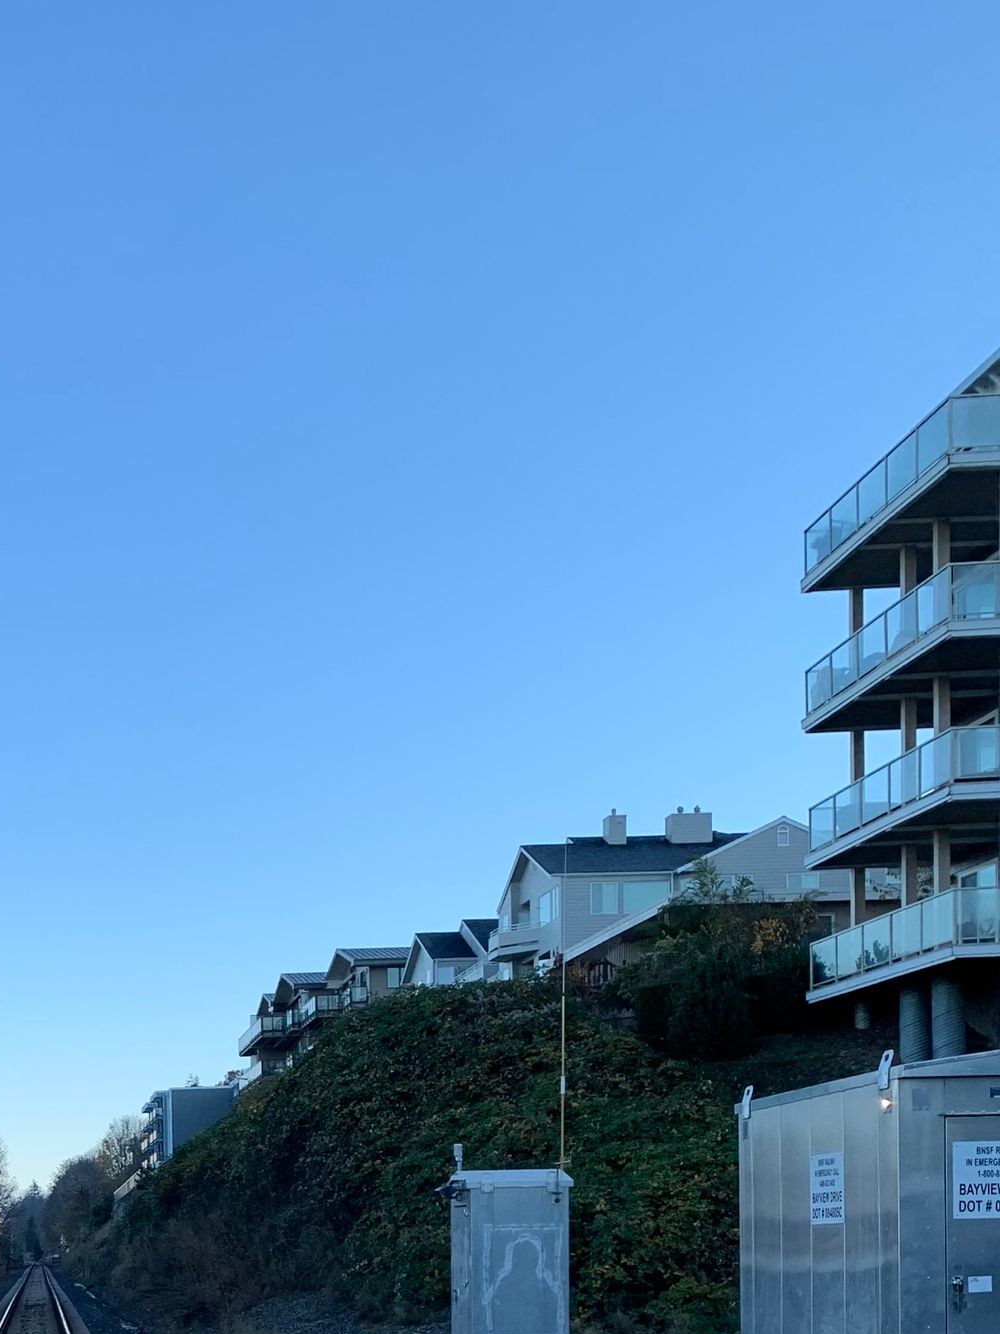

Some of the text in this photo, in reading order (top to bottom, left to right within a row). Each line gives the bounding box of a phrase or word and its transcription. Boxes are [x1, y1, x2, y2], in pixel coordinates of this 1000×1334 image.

[976, 1146, 994, 1155] BNSF
[960, 1183, 1000, 1195] BAYVIE
[959, 1200, 983, 1212] DOT
[986, 1200, 992, 1212] #
